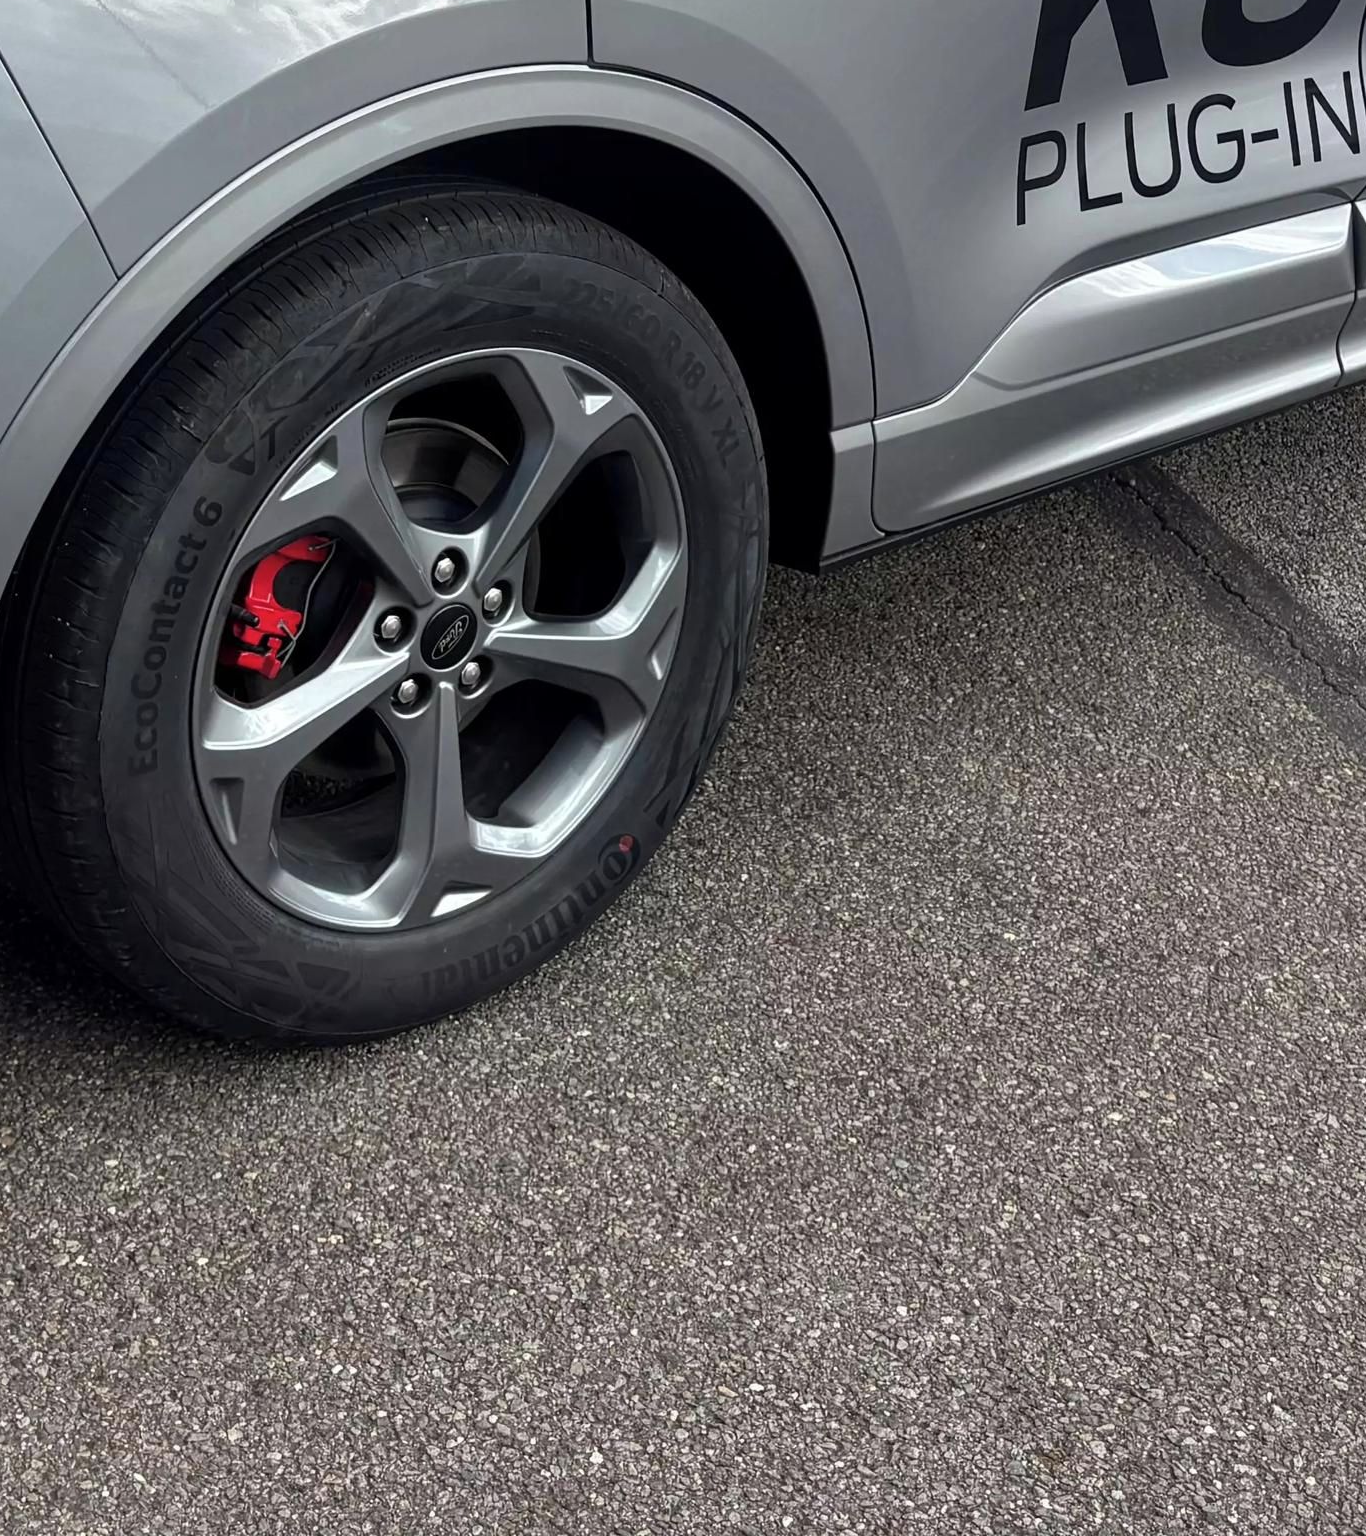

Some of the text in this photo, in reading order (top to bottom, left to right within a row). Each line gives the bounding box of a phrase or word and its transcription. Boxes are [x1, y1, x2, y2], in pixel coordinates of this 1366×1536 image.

[1015, 70, 1363, 227] PLUG-IN
[127, 495, 224, 778] EcoContact 6
